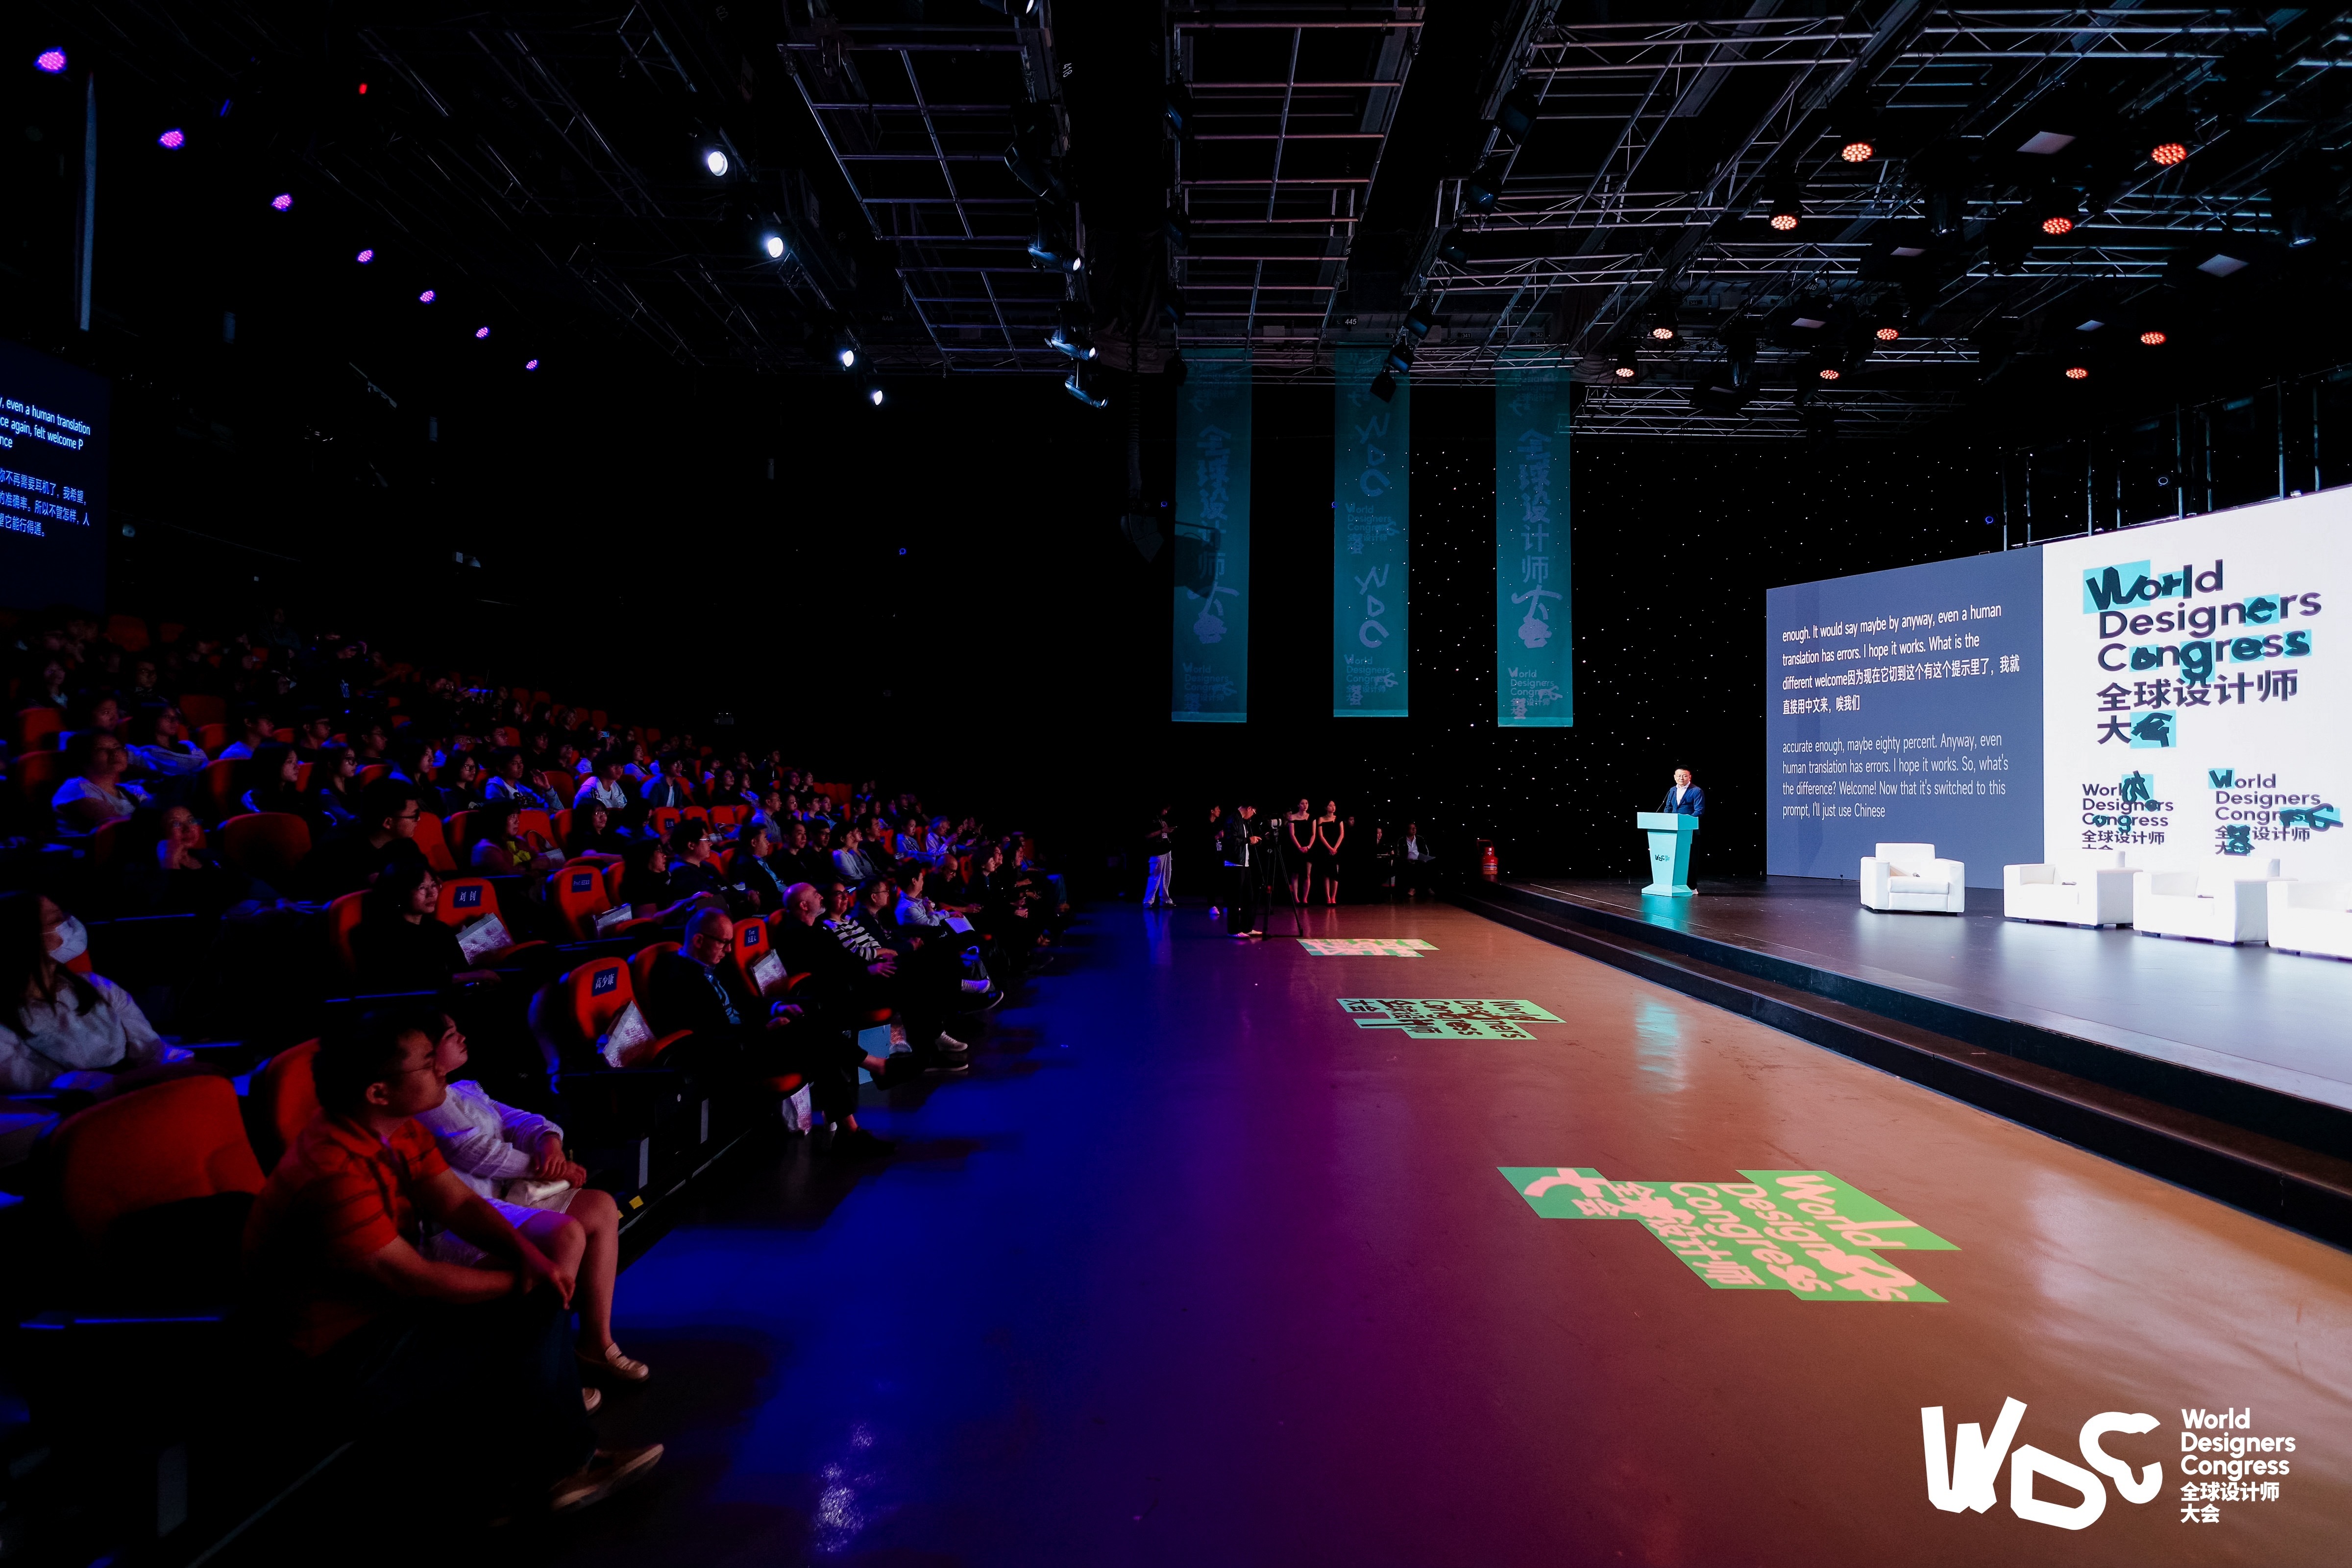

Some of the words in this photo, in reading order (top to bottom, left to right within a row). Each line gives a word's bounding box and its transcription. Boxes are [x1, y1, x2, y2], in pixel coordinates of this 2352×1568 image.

[1062, 63, 1073, 77] 418
[6, 399, 24, 413] even
[25, 406, 30, 415] a
[32, 405, 55, 424] human
[56, 414, 91, 435] translation
[11, 420, 32, 437] again,
[34, 424, 46, 439] felt
[47, 432, 76, 449] welcome
[78, 438, 83, 450] P
[2085, 559, 2223, 610] World
[1782, 626, 1811, 644] enough.
[1813, 625, 1818, 638] It
[1820, 621, 1842, 637] would
[1845, 623, 1858, 638] say
[1860, 616, 1886, 635] maybe
[1889, 615, 1899, 633] by
[1901, 613, 1935, 631] anyway,
[1938, 610, 1959, 624] even
[1961, 609, 1967, 621] a
[1970, 604, 2002, 620] human
[2099, 592, 2322, 639] Designers
[1782, 650, 1819, 666] translation
[1821, 648, 1835, 662] has
[1837, 648, 1861, 661] errors.
[1863, 644, 1866, 658] I
[1868, 643, 1888, 661] hope
[1891, 640, 1897, 655] it
[1899, 638, 1926, 654] works.
[1928, 635, 1952, 651] What
[1955, 633, 1962, 649] is
[1964, 632, 1980, 648] the
[2098, 631, 2311, 682] Congress
[1184, 674, 1229, 684] Designers
[1346, 665, 1391, 675] Designers
[1508, 667, 1537, 678] World
[1510, 678, 1555, 688] Designers
[1782, 675, 1813, 690] different
[1814, 673, 1848, 687] welcome
[2096, 669, 2298, 712] 全球设计师
[1783, 740, 1813, 753] accurate
[1815, 737, 1844, 755] enough,
[1847, 736, 1873, 755] maybe
[1875, 735, 1901, 754] eighty
[1903, 734, 1937, 753] percent.
[1940, 733, 1977, 752] Anyway,
[1980, 735, 2002, 747] even
[1783, 760, 1806, 774] human
[1809, 759, 1847, 773] translation
[1850, 759, 1863, 773] has
[1865, 762, 1891, 772] errors.
[1894, 758, 1896, 772] I
[1899, 757, 1919, 776] hope
[1923, 757, 1928, 772] it
[1931, 756, 1959, 772] works.
[1962, 755, 1976, 773] So,
[1979, 753, 2009, 771] what's
[1782, 781, 1794, 795] the
[1796, 781, 1837, 795] difference?
[1838, 781, 1876, 795] Welcome!
[1879, 780, 1898, 795] Now
[1900, 780, 1917, 795] that
[1920, 778, 1932, 795] it's
[1934, 779, 1973, 795] switched
[1976, 780, 1985, 795] to
[1988, 779, 2006, 795] this
[2208, 769, 2276, 789] World
[1783, 803, 1810, 820] prompt,
[1821, 802, 1836, 820] just
[1838, 806, 1852, 817] use
[1854, 802, 1886, 818] Chinese
[2216, 791, 2321, 809] Designers
[595, 973, 614, 989] 高少康
[1775, 1175, 1919, 1248] World
[1669, 1183, 1833, 1293] Congress
